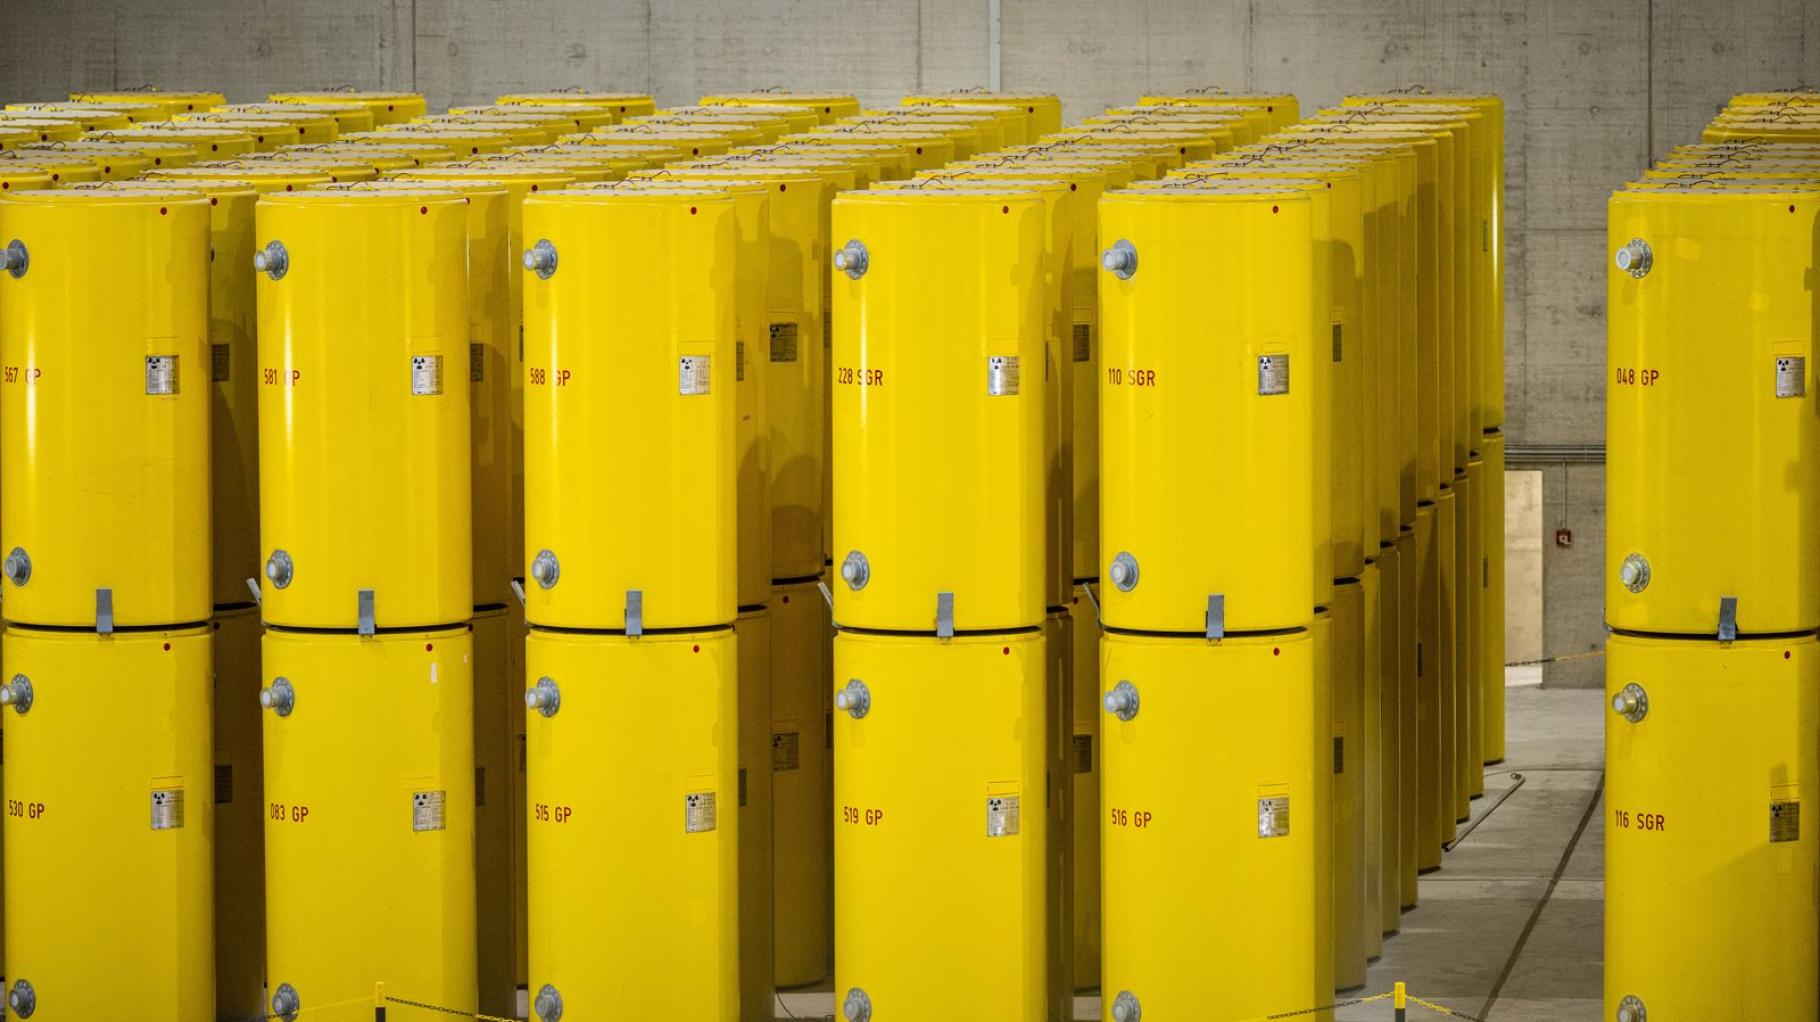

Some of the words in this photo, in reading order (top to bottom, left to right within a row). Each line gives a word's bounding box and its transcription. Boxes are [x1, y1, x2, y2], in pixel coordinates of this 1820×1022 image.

[5, 366, 19, 383] 567
[264, 368, 278, 385] 581
[530, 368, 545, 385] 588
[838, 367, 853, 384] 228
[857, 368, 883, 386] SGR
[1109, 368, 1123, 385] 110
[1128, 369, 1156, 387] SGR
[1616, 368, 1635, 385] 048
[1641, 369, 1659, 387] GP
[9, 800, 23, 818] 530
[29, 802, 45, 820] GP
[270, 803, 286, 821] 083
[291, 805, 309, 823] GP
[536, 803, 550, 821] 515
[555, 805, 572, 823] GP
[844, 806, 860, 824] 519
[865, 809, 883, 827] GP
[1112, 808, 1128, 826] 516
[1133, 811, 1152, 828] GP
[1615, 810, 1629, 828] 116
[1636, 812, 1665, 831] SGR
